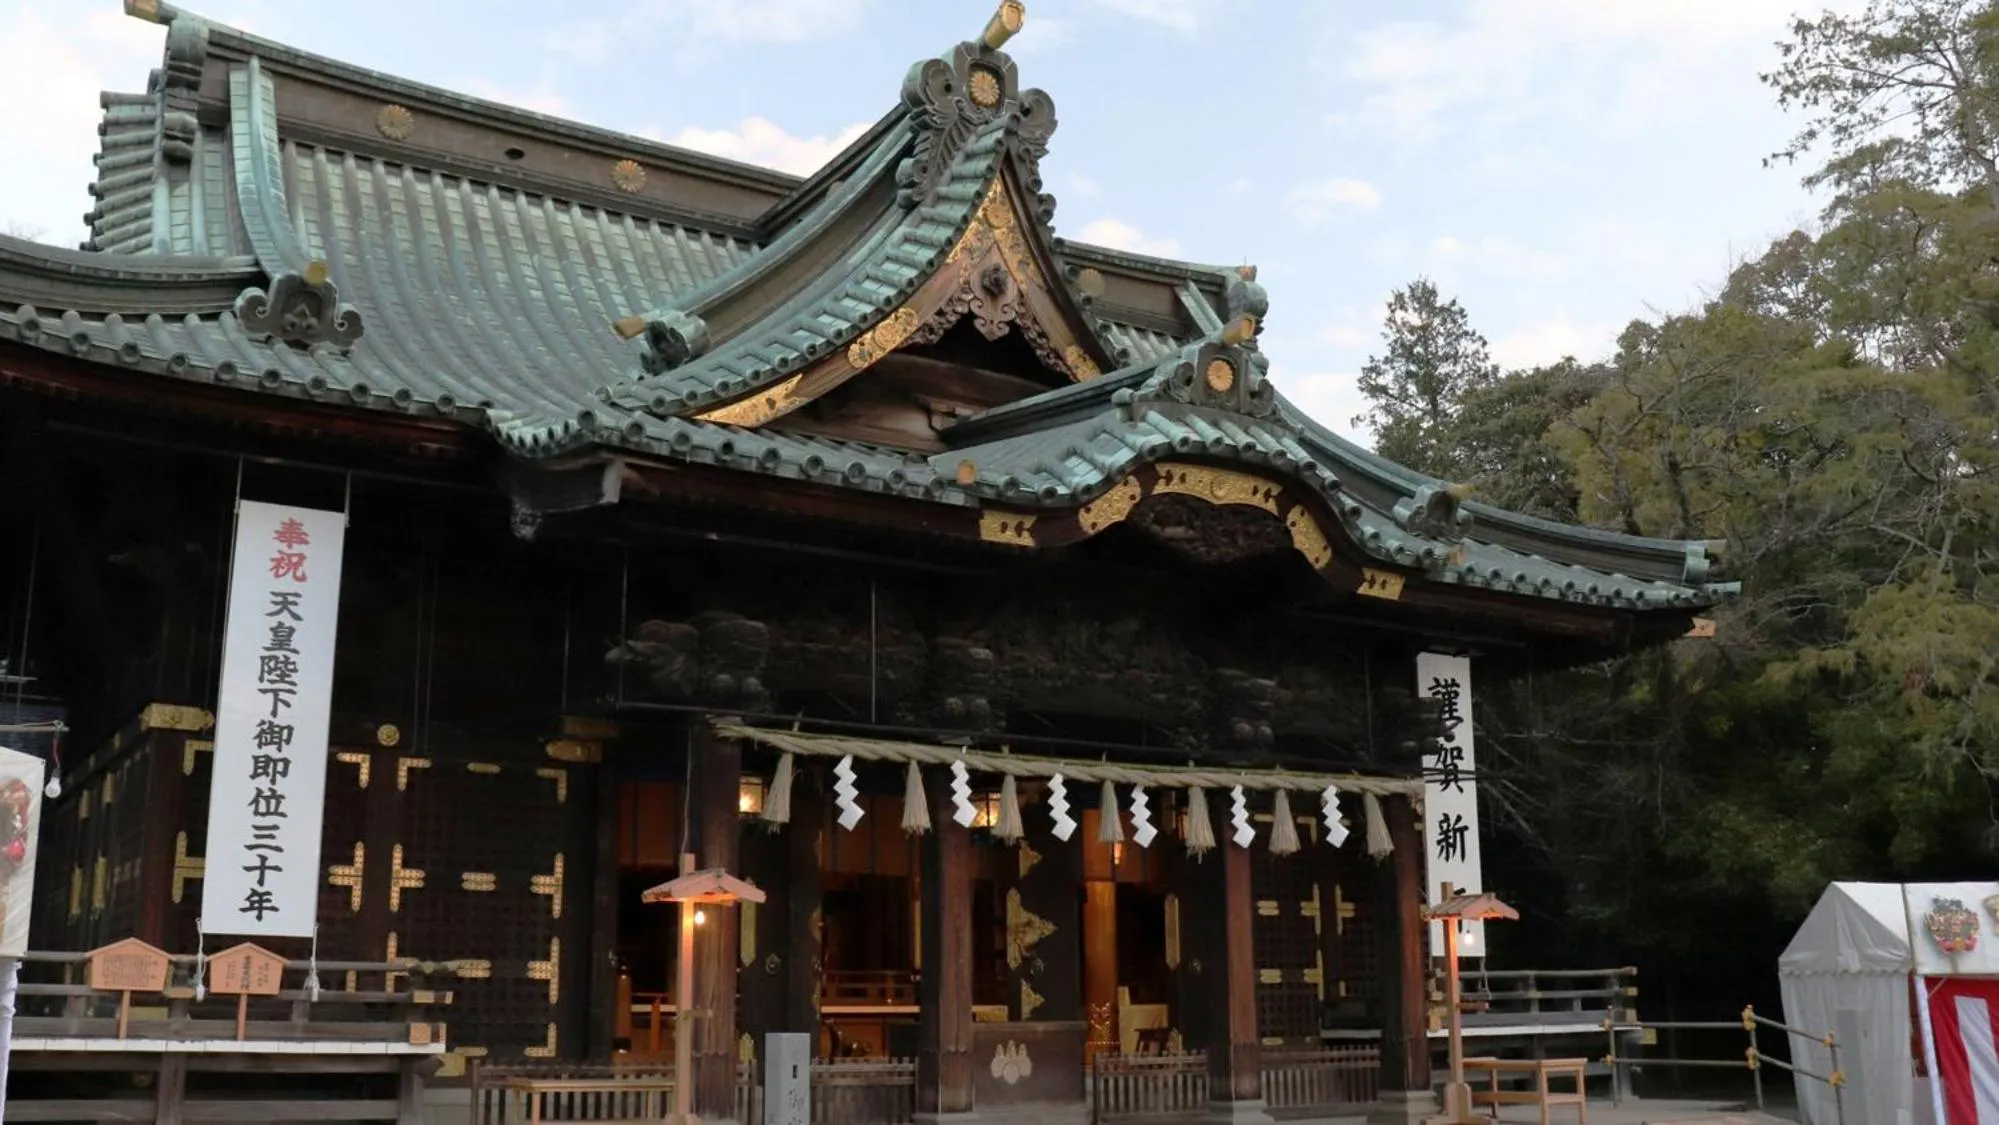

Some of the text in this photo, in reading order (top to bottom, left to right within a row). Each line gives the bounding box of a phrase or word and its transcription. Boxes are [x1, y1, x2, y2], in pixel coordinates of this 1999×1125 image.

[238, 517, 311, 922] 奉祝 天皇陛下御即位三十年
[1427, 677, 1468, 934] 謹賀新
